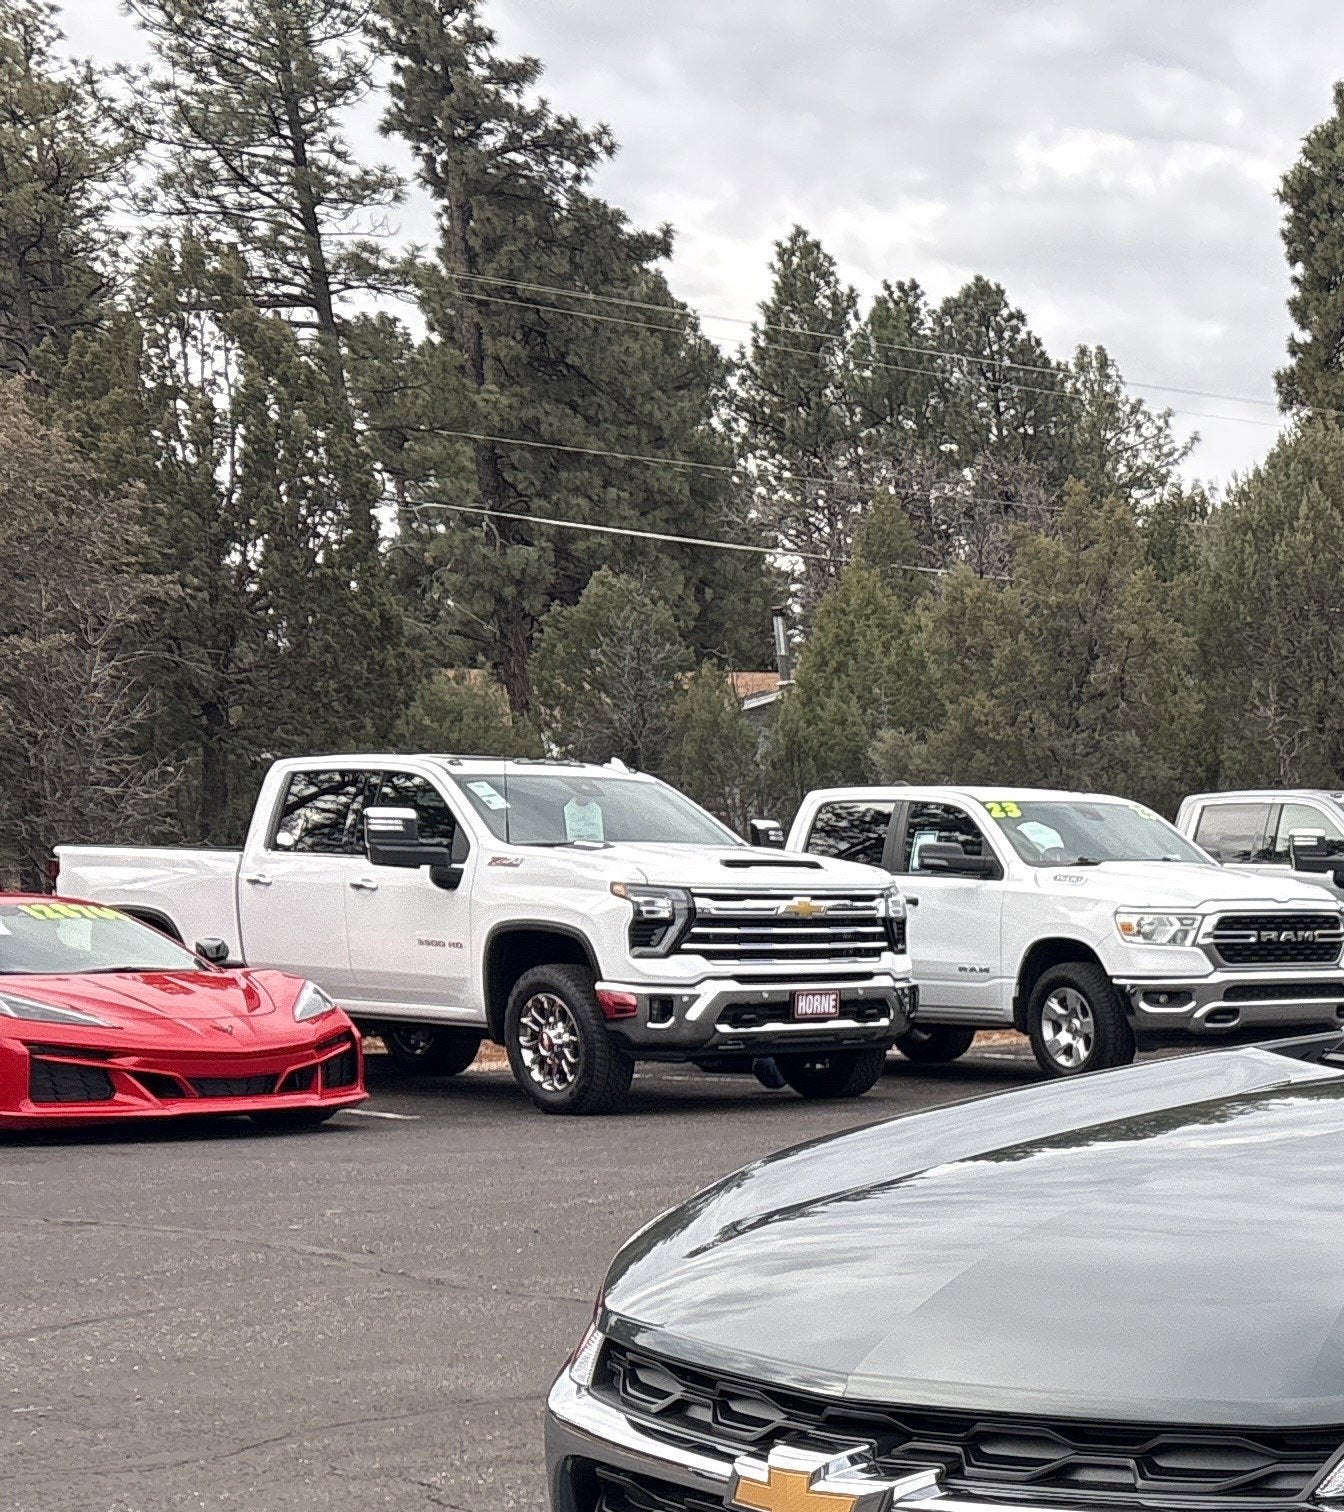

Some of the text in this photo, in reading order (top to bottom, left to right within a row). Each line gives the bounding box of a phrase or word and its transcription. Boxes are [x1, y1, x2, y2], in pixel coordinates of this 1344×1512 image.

[984, 802, 1021, 818] 23
[1260, 930, 1314, 942] RAM
[797, 993, 837, 1015] HORNE
